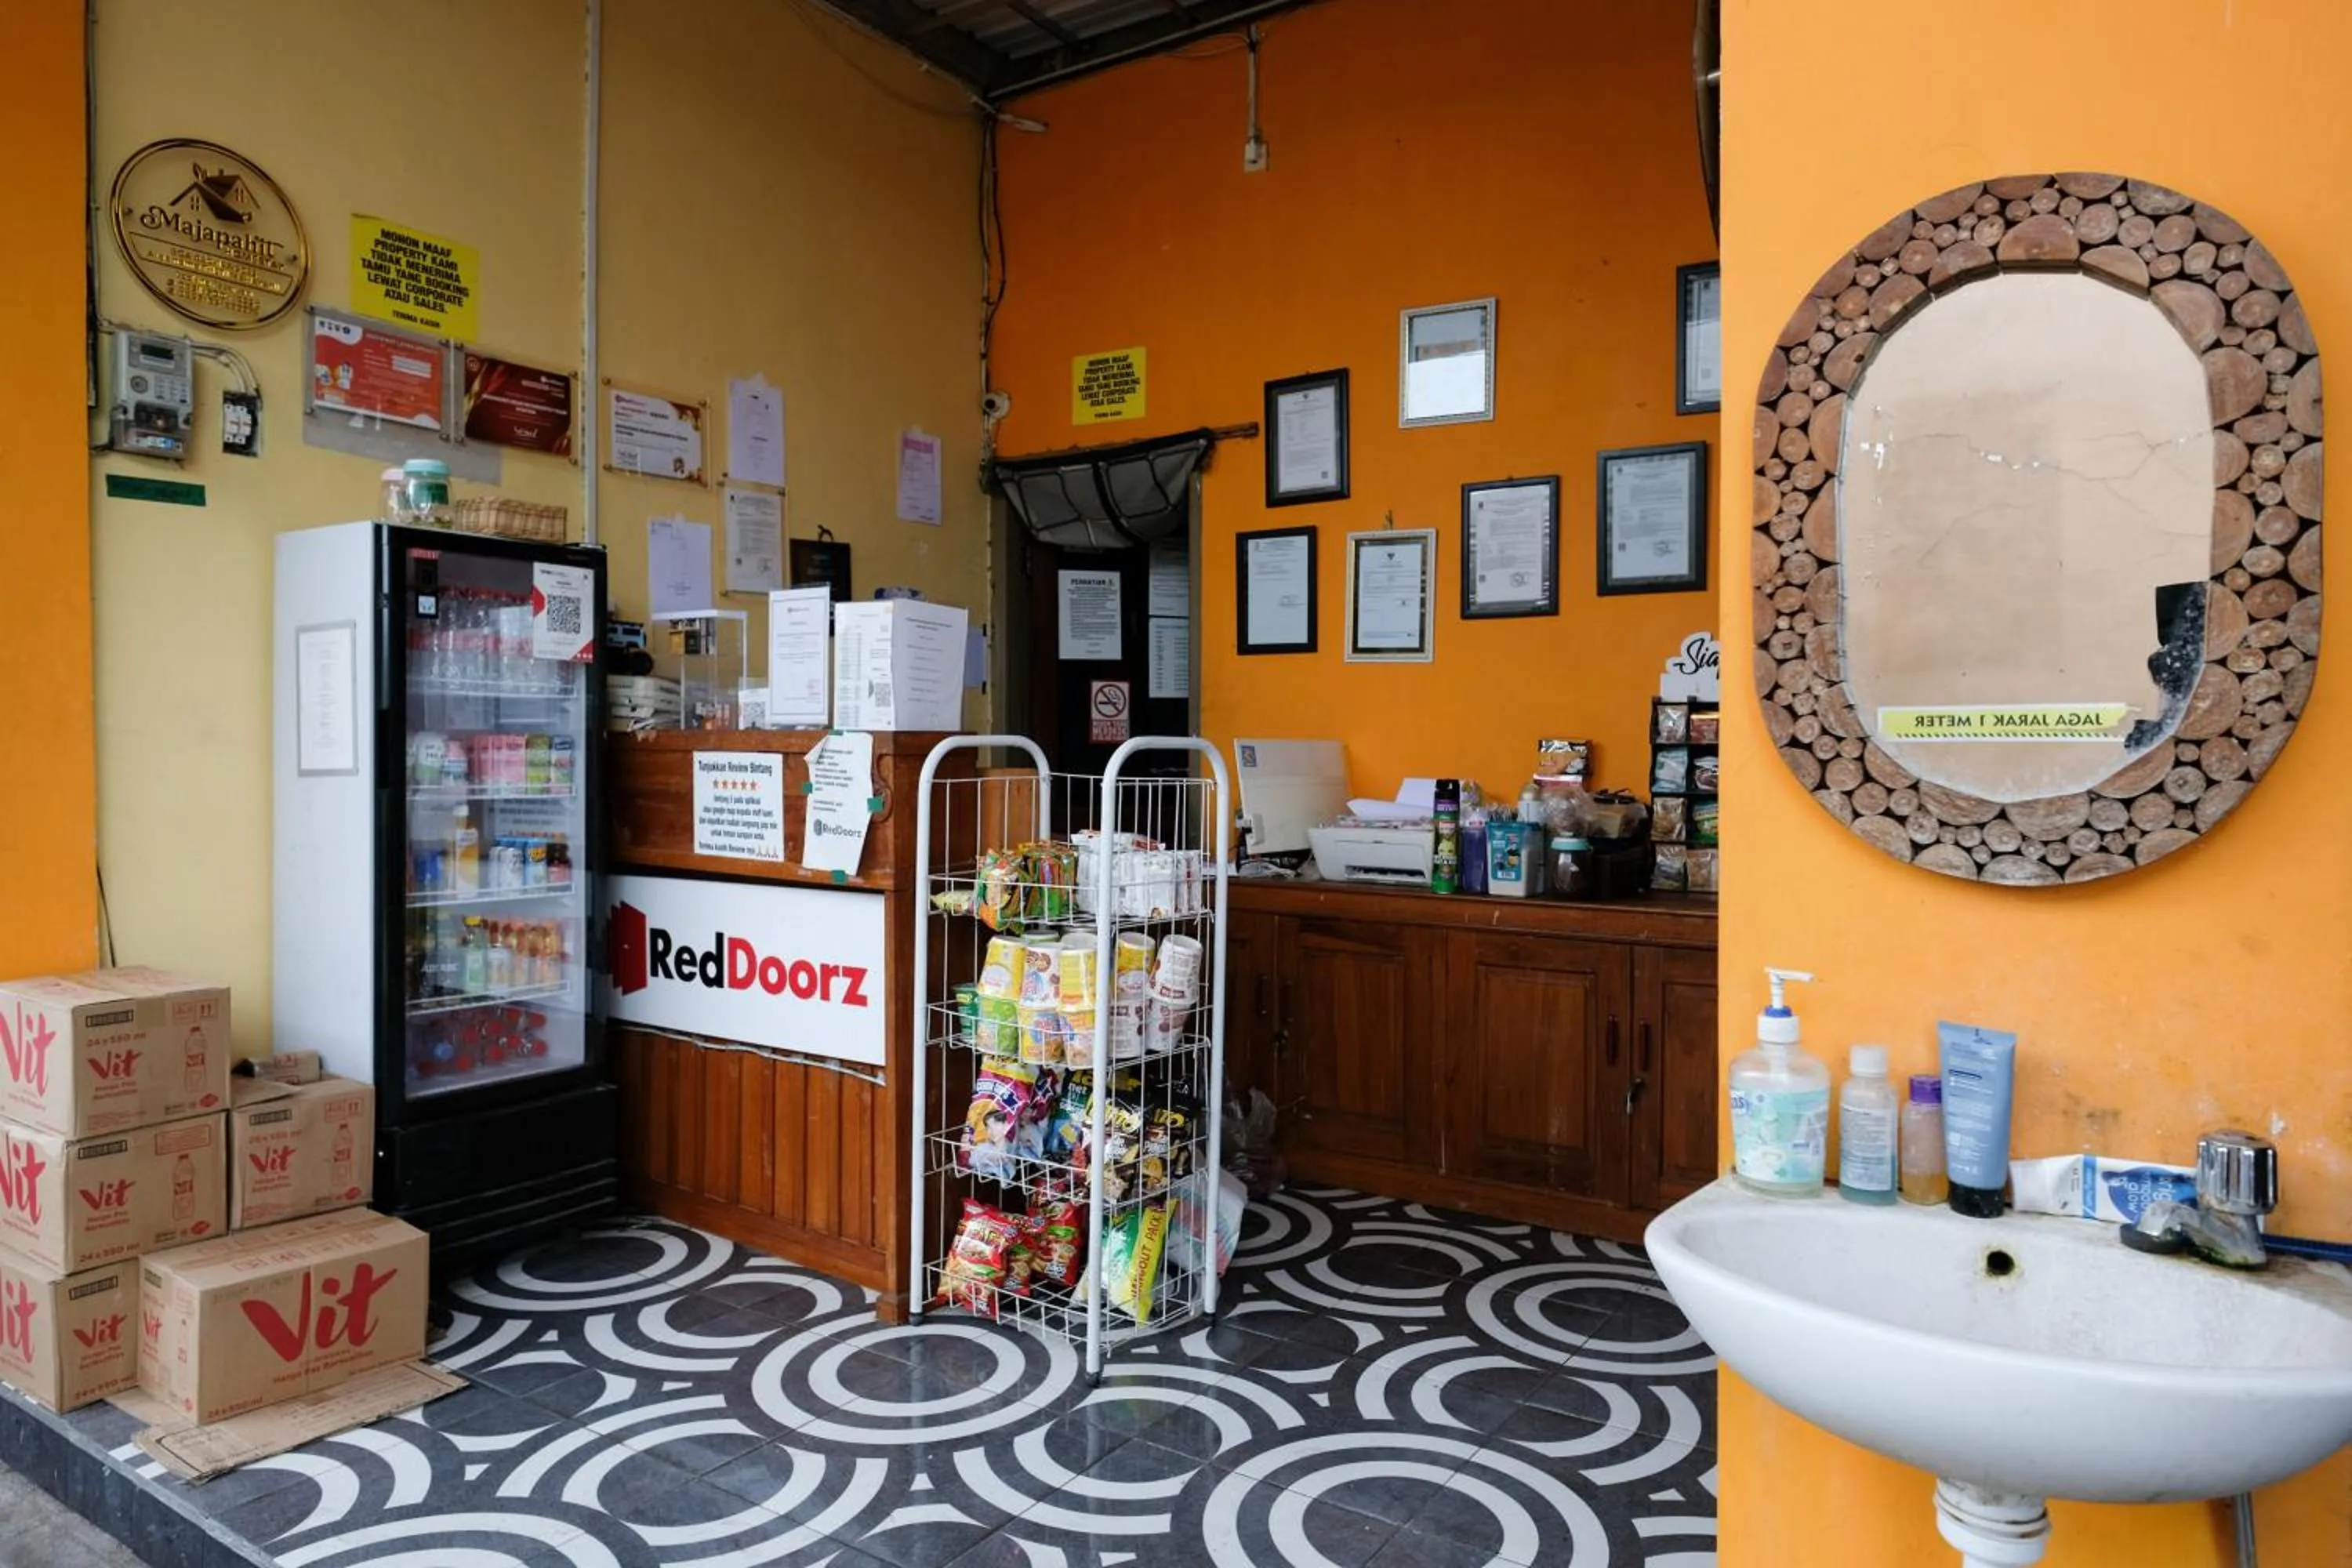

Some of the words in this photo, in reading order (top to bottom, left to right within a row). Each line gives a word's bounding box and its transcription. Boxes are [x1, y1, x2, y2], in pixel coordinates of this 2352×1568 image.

[140, 205, 285, 257] Majapahit
[381, 229, 419, 249] MOHON
[423, 241, 452, 257] MAAF
[371, 249, 401, 266] TIDAK
[406, 260, 461, 284] MENERIMA
[375, 238, 426, 261] PROPERTY
[432, 256, 458, 271] KAMI
[361, 258, 390, 274] TAMU
[396, 267, 422, 284] YANG
[425, 276, 470, 298] BOOKING
[368, 273, 401, 289] LEWAT
[405, 282, 463, 307] CORPORATE
[384, 289, 410, 303] ATAU
[750, 762, 772, 777] Bintang
[823, 822, 862, 837] RedDoorz
[649, 927, 869, 1007] RedDoorz
[0, 1000, 56, 1098] Vit
[87, 1049, 143, 1080] Vit
[249, 1145, 297, 1173] Vit
[78, 1179, 136, 1210] Vit
[0, 1274, 38, 1363] it
[240, 1262, 398, 1362] Vit
[73, 1313, 128, 1348] Vit
